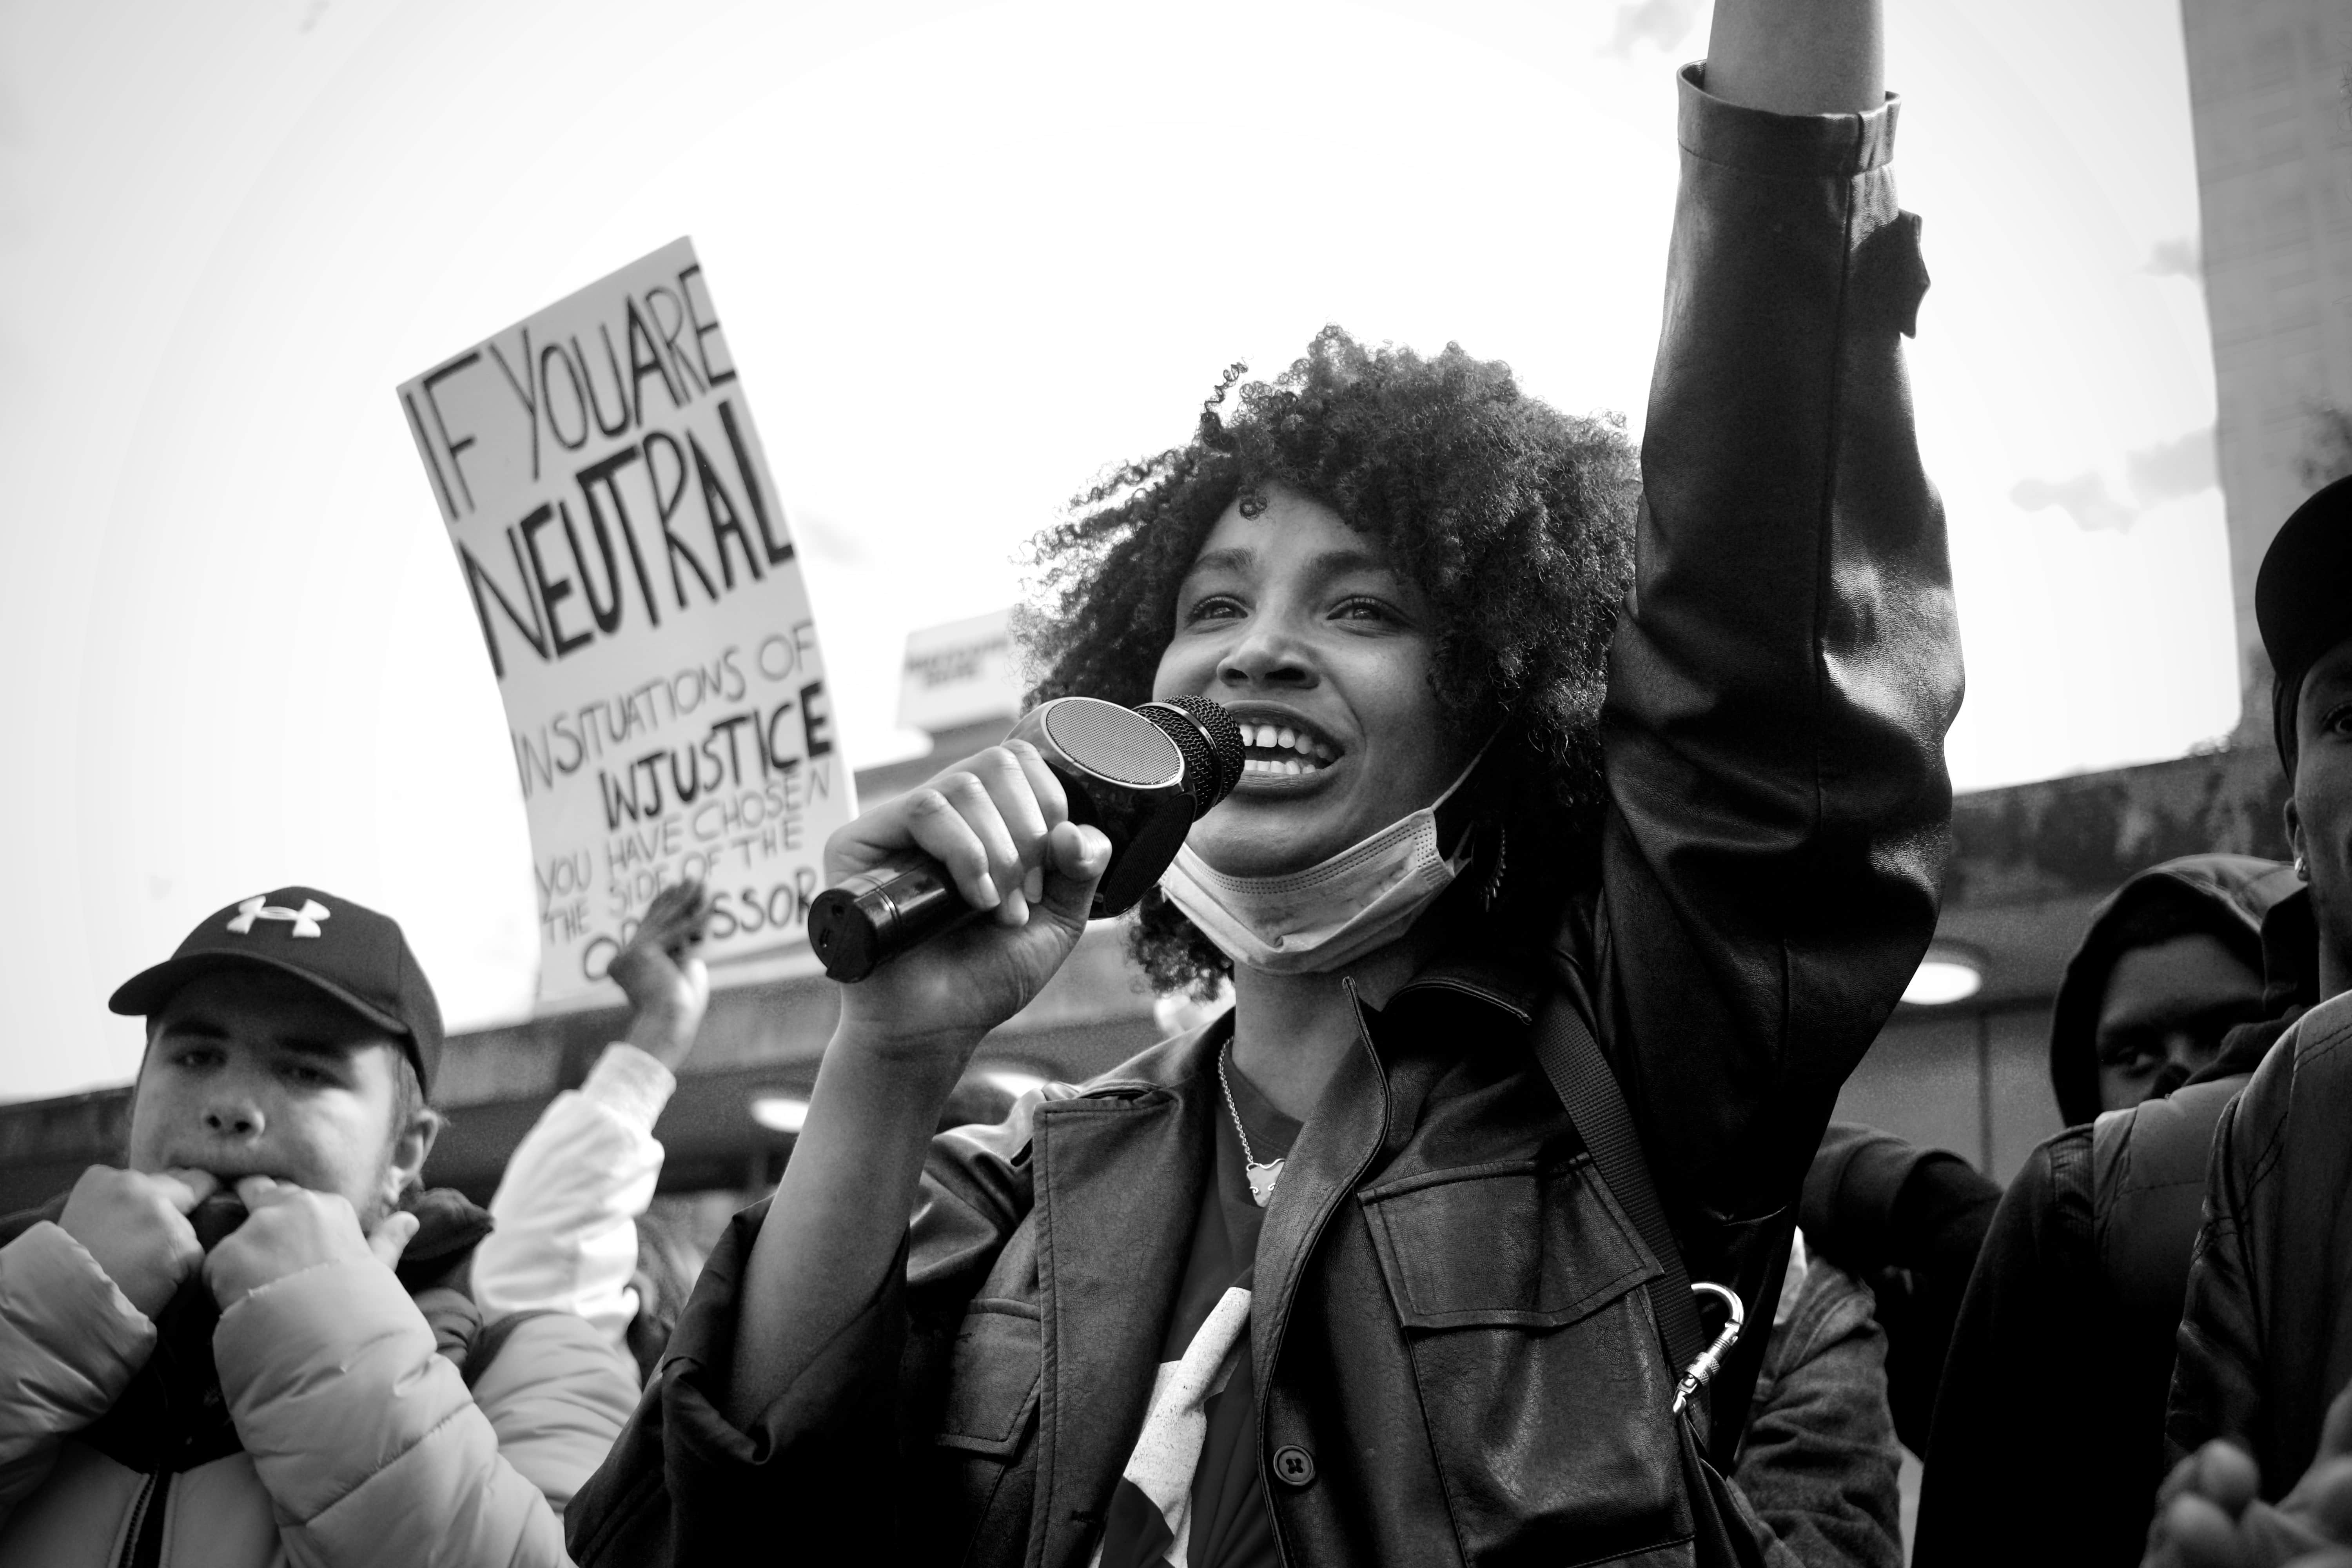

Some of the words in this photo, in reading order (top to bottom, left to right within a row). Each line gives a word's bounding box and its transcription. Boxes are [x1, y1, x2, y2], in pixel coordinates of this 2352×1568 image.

[404, 350, 481, 522] IF
[457, 398, 795, 681] NEUTRAL
[757, 619, 814, 682] OF
[599, 681, 834, 831] INJUSTICE
[534, 849, 592, 918] YOU
[607, 812, 682, 877] HAVE
[693, 760, 830, 841] CHOSEN
[544, 897, 590, 944] THE
[682, 844, 724, 880] OF
[731, 813, 804, 868] THE
